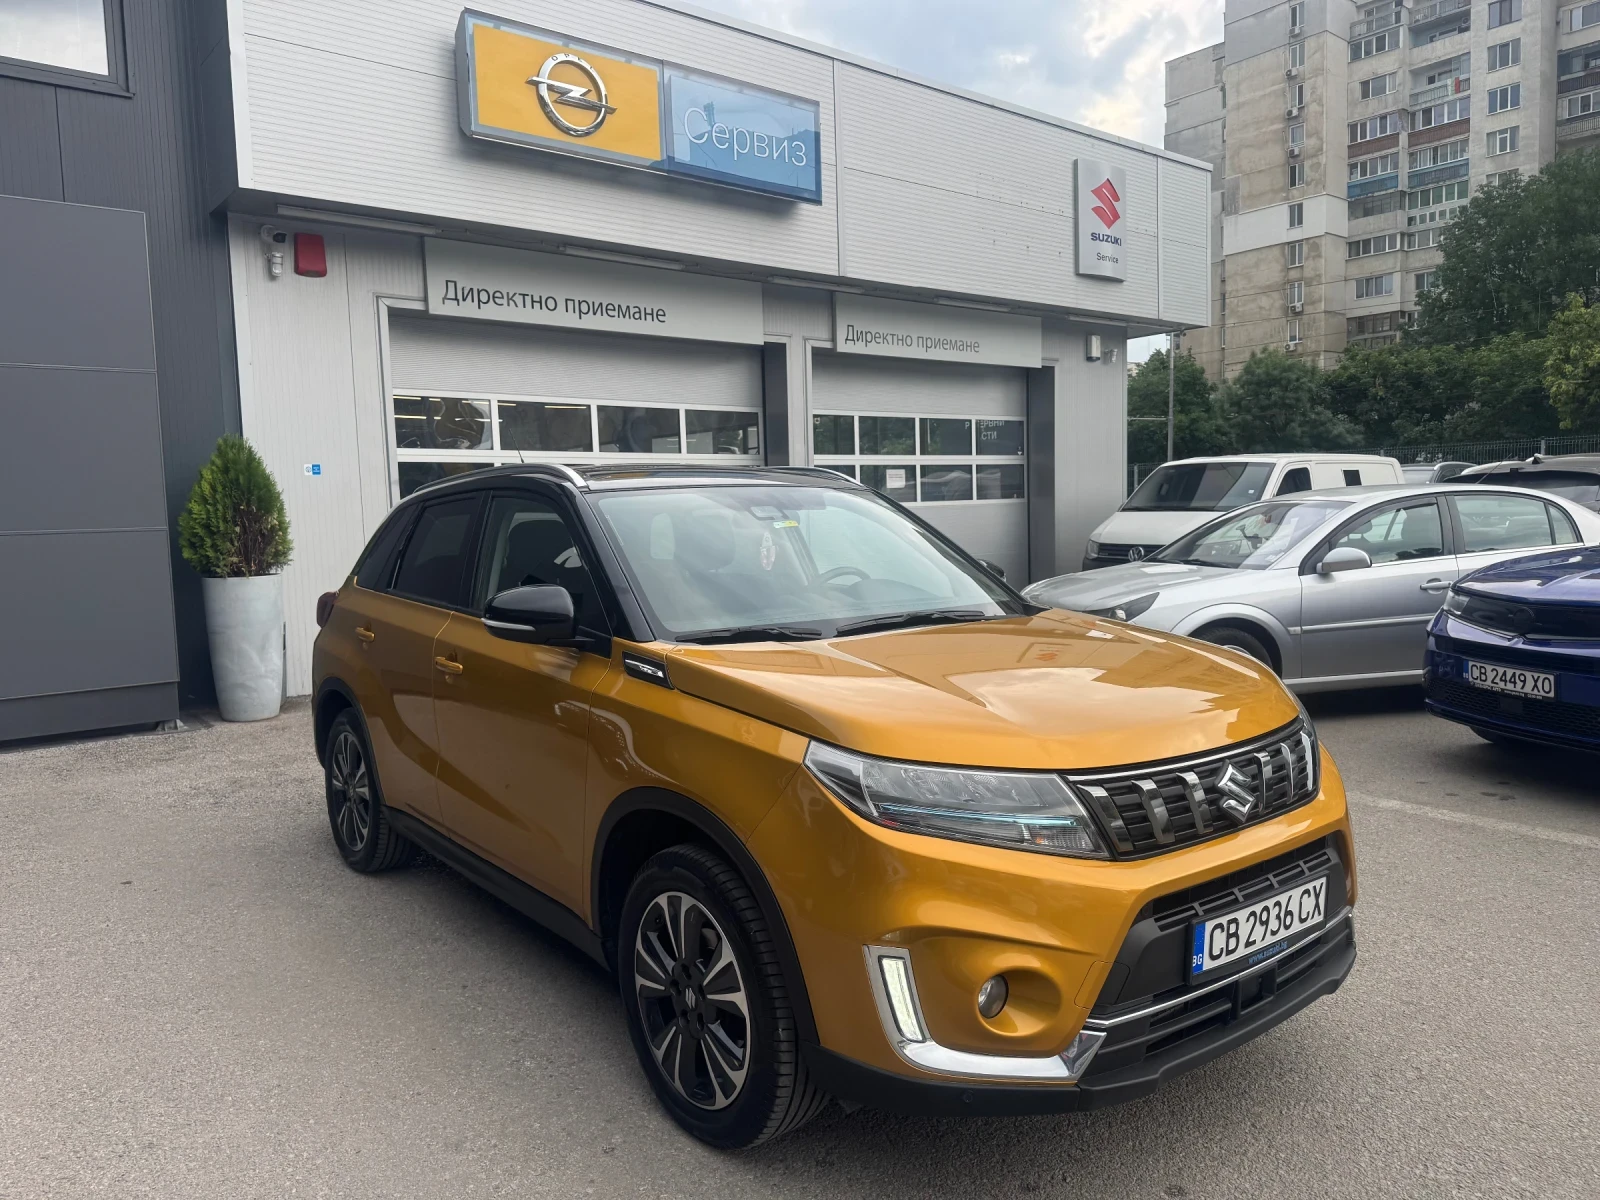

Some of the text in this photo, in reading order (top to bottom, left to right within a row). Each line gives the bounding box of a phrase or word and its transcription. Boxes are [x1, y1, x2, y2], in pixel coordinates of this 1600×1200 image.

[684, 107, 807, 166] Сервиз
[1090, 232, 1122, 246] SUZUKI
[1096, 252, 1119, 264] Service
[442, 279, 667, 324] Директно приемане
[844, 324, 980, 353] Директно приемане
[1470, 664, 1488, 682] CB
[1490, 668, 1527, 690] 2449
[1208, 881, 1324, 961] CB 2936 CX
